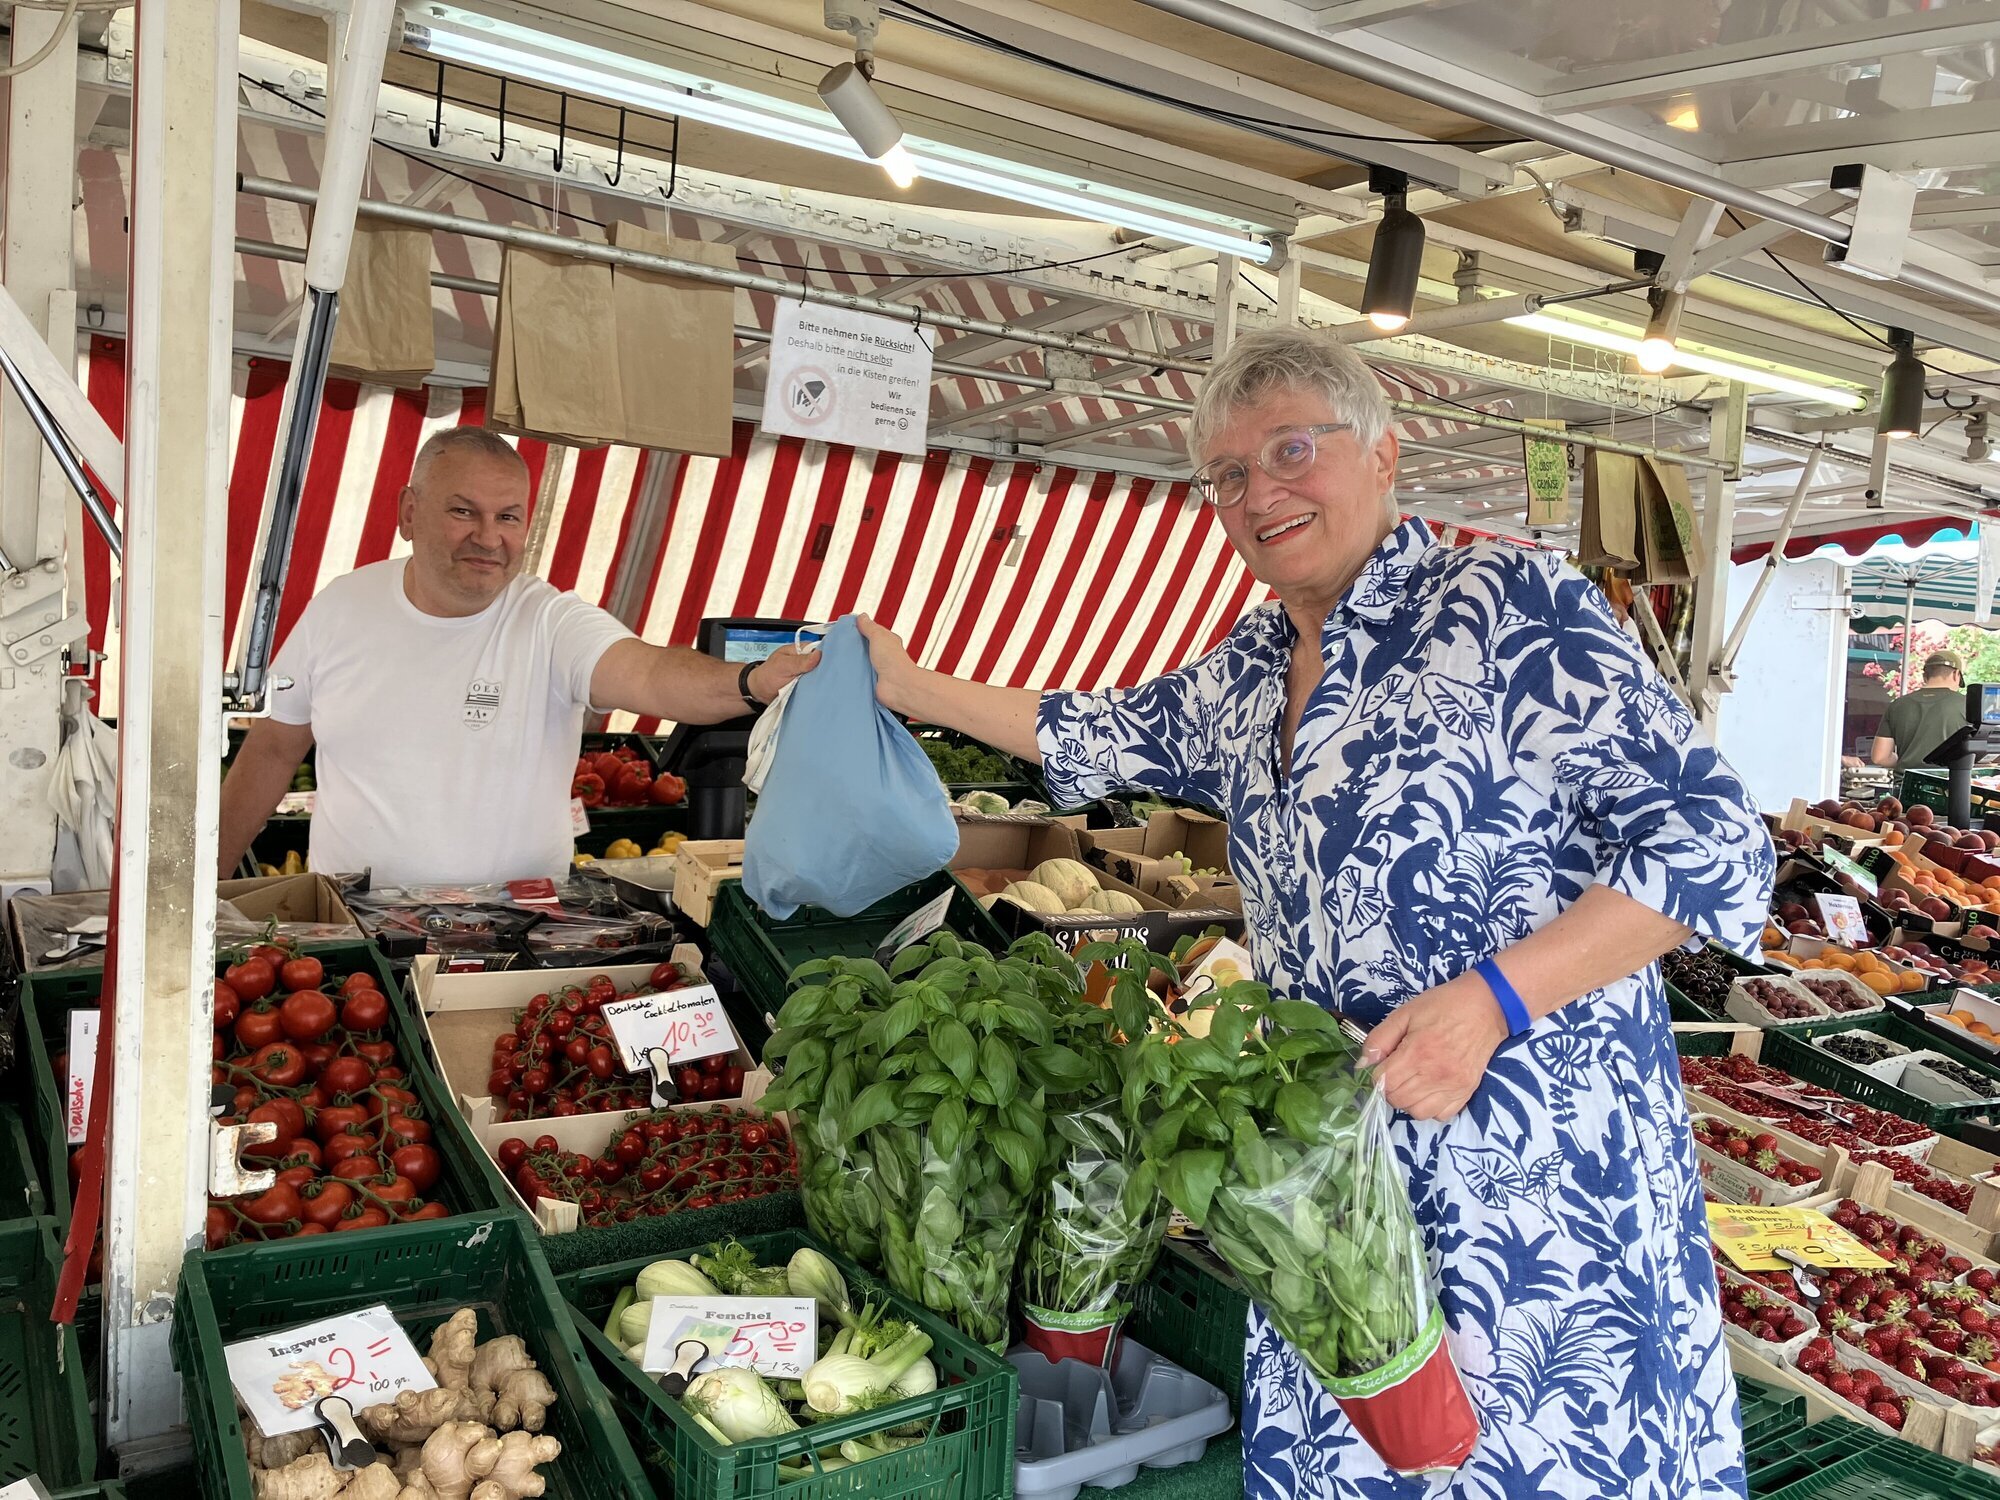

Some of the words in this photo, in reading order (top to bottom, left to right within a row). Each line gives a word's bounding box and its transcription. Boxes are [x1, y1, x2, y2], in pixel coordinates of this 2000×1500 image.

[799, 321, 820, 333] Bitte
[822, 327, 858, 341] nehmen
[860, 333, 873, 344] Sie
[875, 336, 915, 353] Rücksicht!
[788, 337, 823, 351] Deshalb
[825, 343, 845, 356] bitte
[847, 348, 868, 360] nicht
[870, 352, 893, 365] selbst
[837, 364, 846, 374] in
[847, 366, 861, 377] die
[863, 370, 887, 382] Kisten
[888, 375, 920, 388] greifen!
[888, 391, 901, 400] Wir
[870, 401, 904, 415] bedienen
[905, 407, 916, 417] Sie
[875, 417, 896, 427] gerne
[1737, 1243, 1746, 1251] 2
[705, 1311, 772, 1320] Fenchel
[268, 1331, 337, 1358] Ingwer
[369, 1378, 390, 1393] 100
